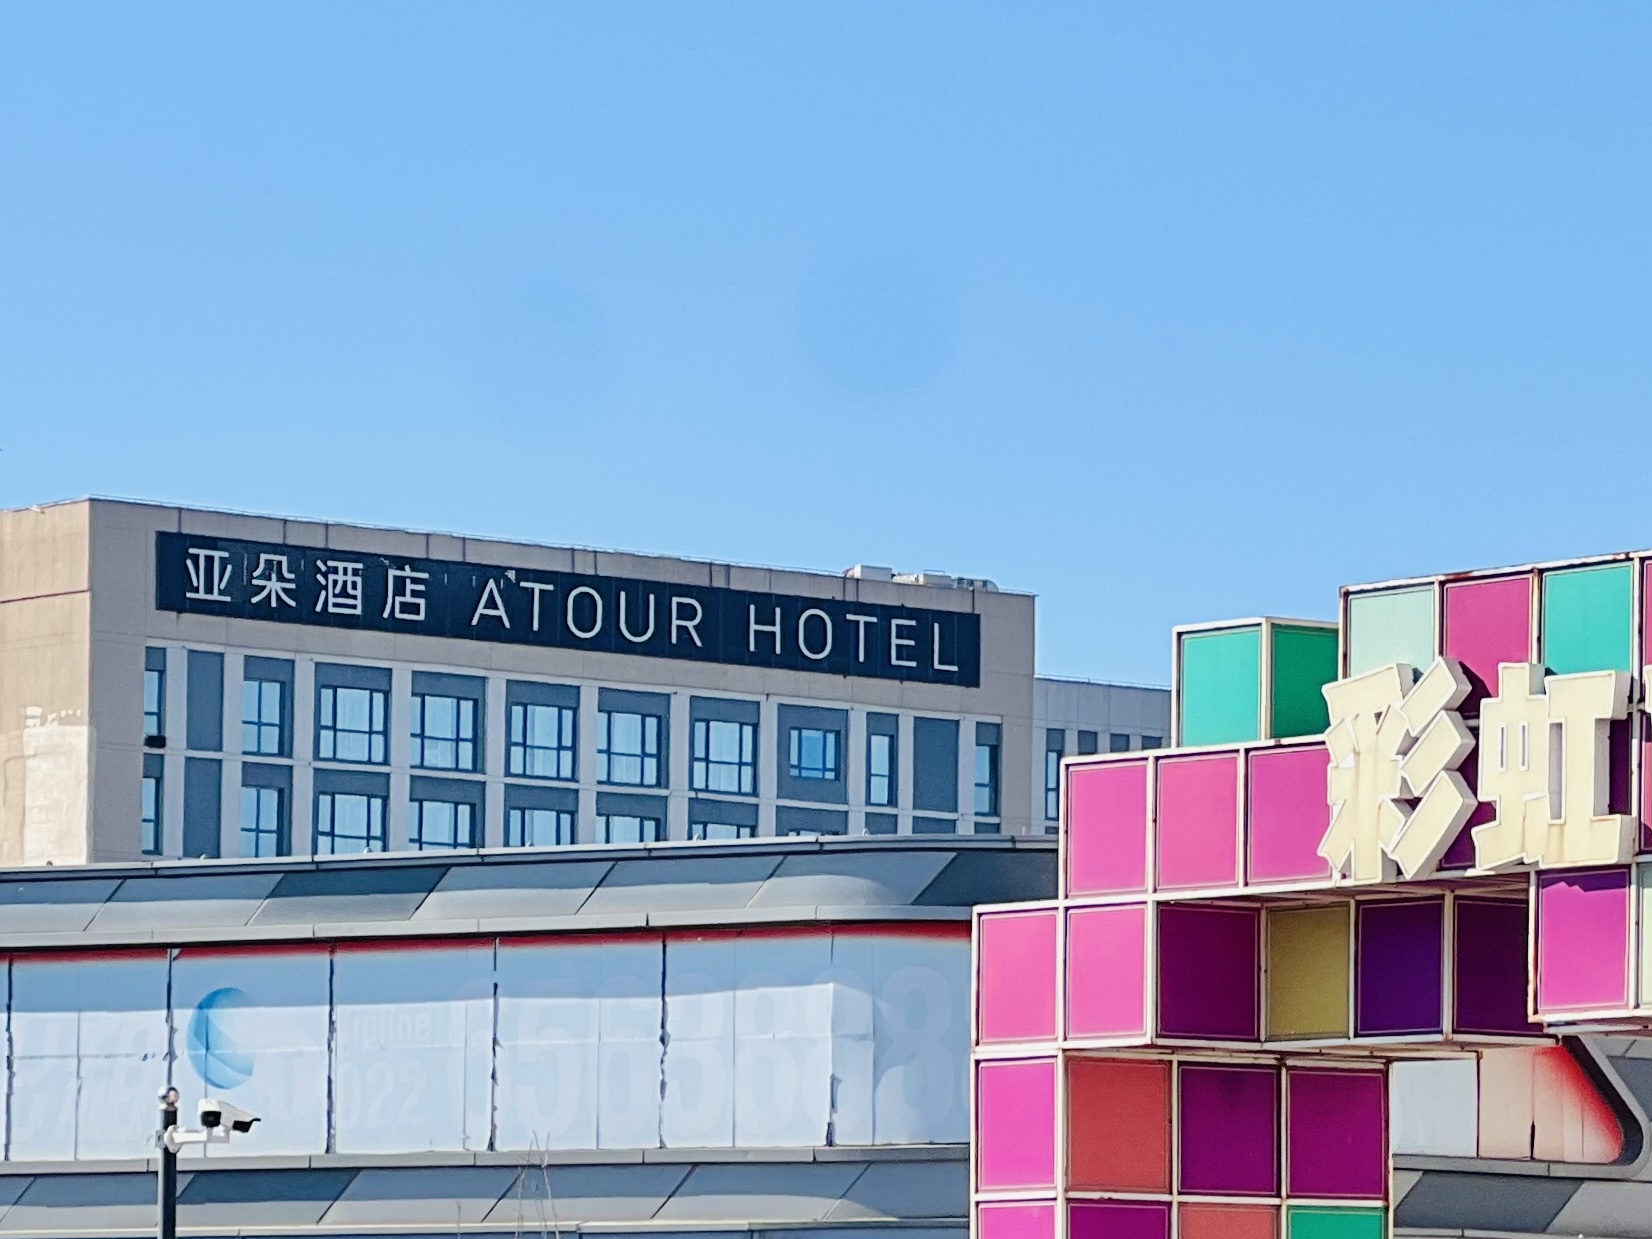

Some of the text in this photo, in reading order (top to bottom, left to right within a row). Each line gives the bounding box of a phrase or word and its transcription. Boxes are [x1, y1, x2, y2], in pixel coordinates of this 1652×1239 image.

[185, 546, 960, 672] 亚朵酒店 ATOUR HOTEL
